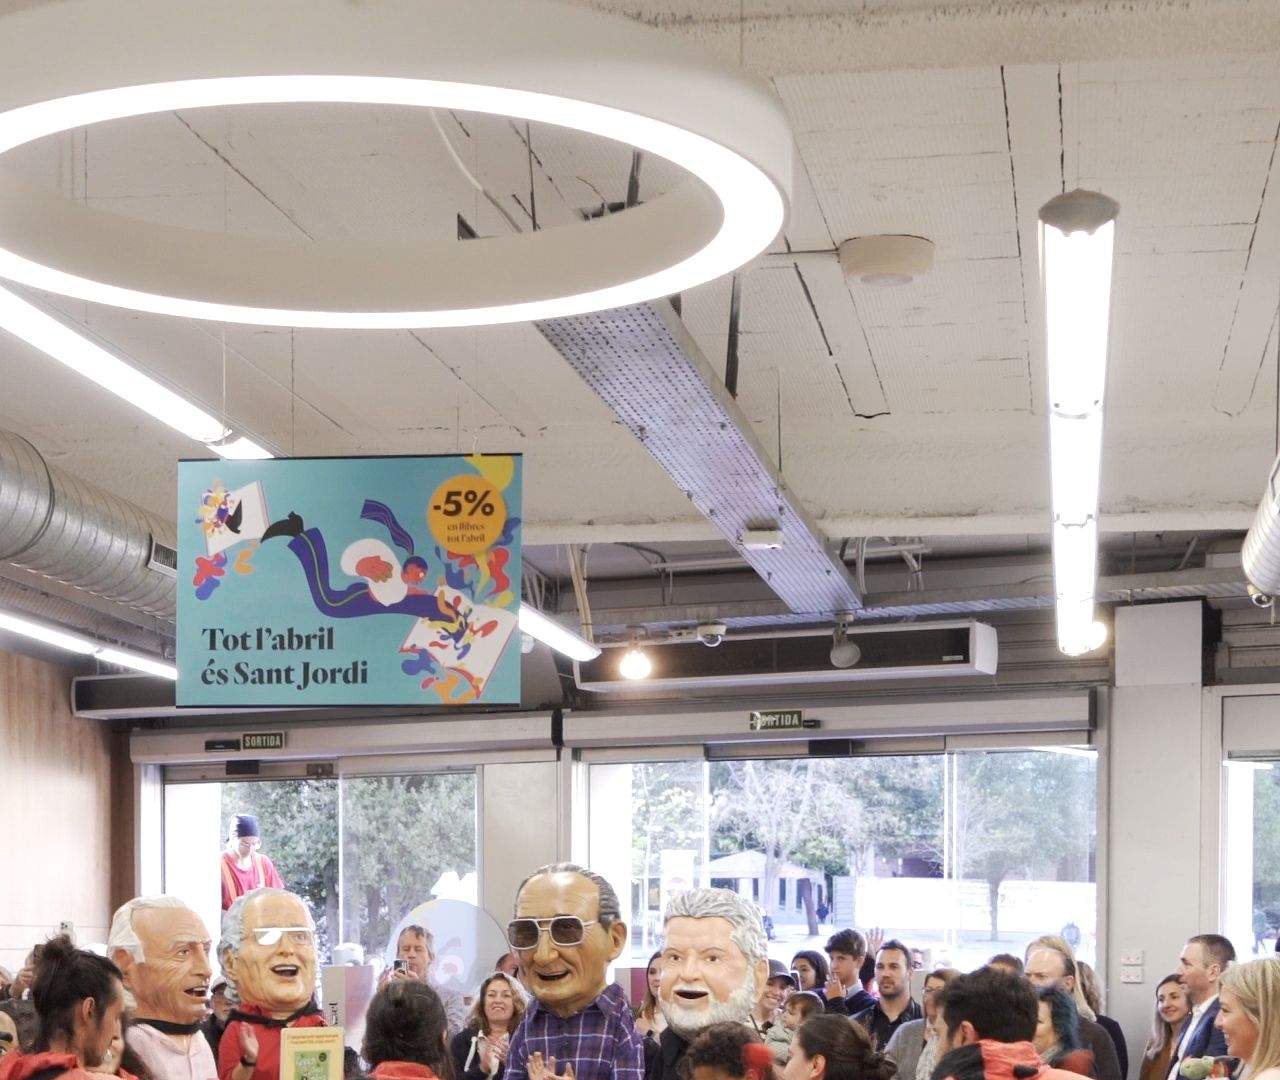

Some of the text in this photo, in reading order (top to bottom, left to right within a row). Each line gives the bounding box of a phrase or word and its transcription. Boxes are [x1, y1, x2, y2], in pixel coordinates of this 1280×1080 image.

[433, 490, 495, 517] -5%
[460, 522, 485, 531] llibres
[201, 628, 253, 651] Tot
[201, 659, 368, 690] és Sant Jordi
[244, 735, 281, 747] SORTIDA
